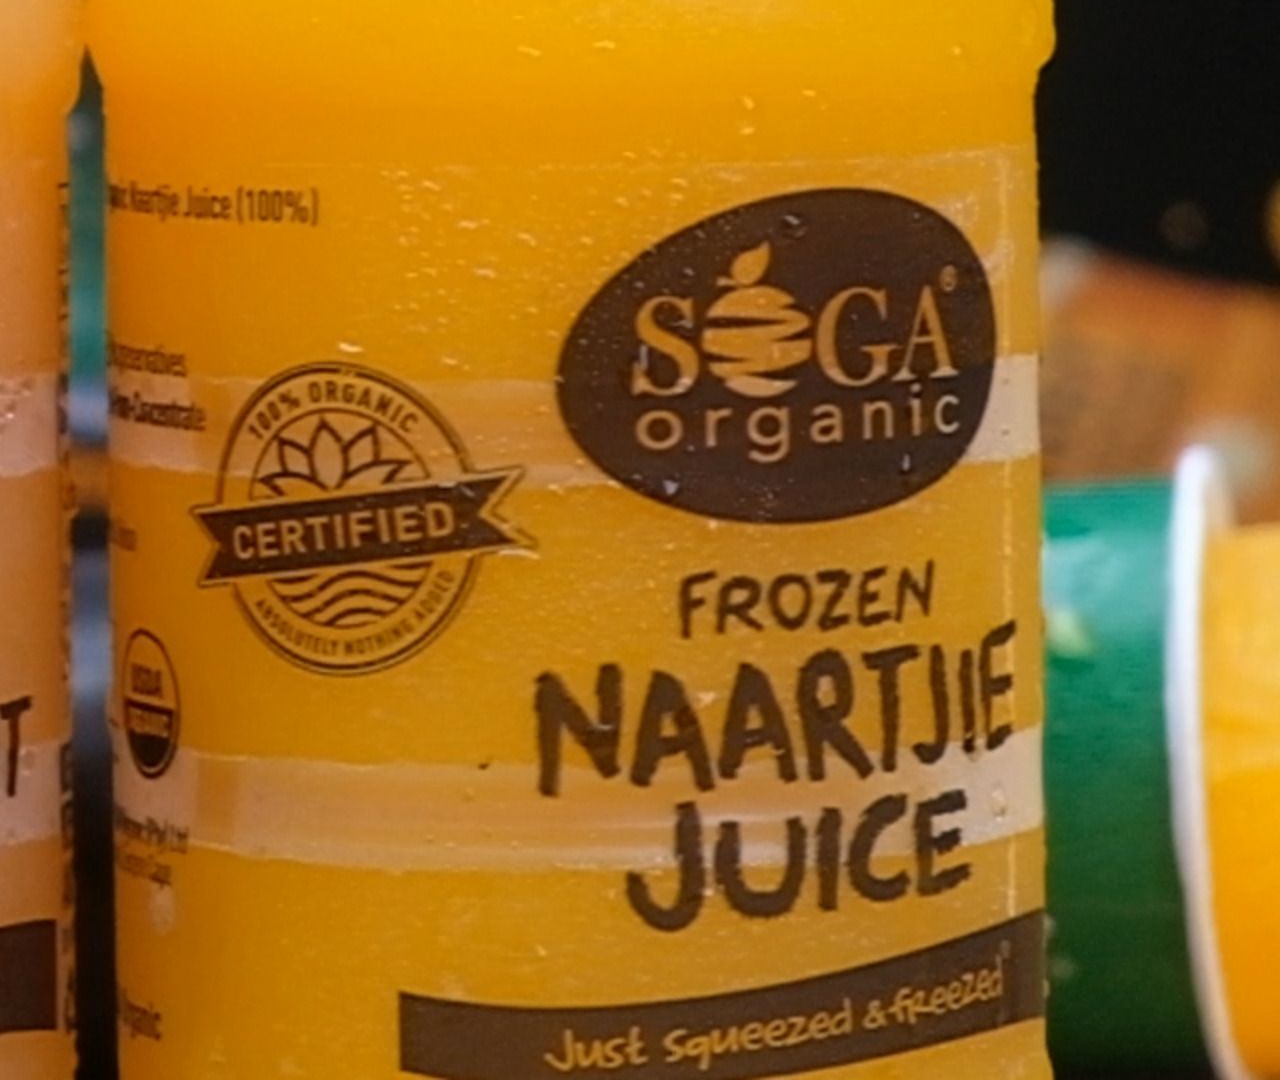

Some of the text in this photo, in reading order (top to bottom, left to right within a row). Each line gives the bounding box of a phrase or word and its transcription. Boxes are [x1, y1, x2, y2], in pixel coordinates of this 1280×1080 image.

[183, 185, 231, 219] Juice
[237, 185, 320, 227] (100%)
[248, 380, 420, 440] 100% ORGANIC
[638, 388, 960, 462] organic
[232, 502, 455, 561] CERTIFIED
[678, 560, 934, 638] FROZEN
[343, 616, 415, 657] NOTHING
[534, 619, 1017, 797] NAARTJIE
[624, 788, 972, 934] JUICE
[543, 1025, 648, 1074] Just
[663, 997, 854, 1071] squeezed
[862, 1001, 886, 1031] &
